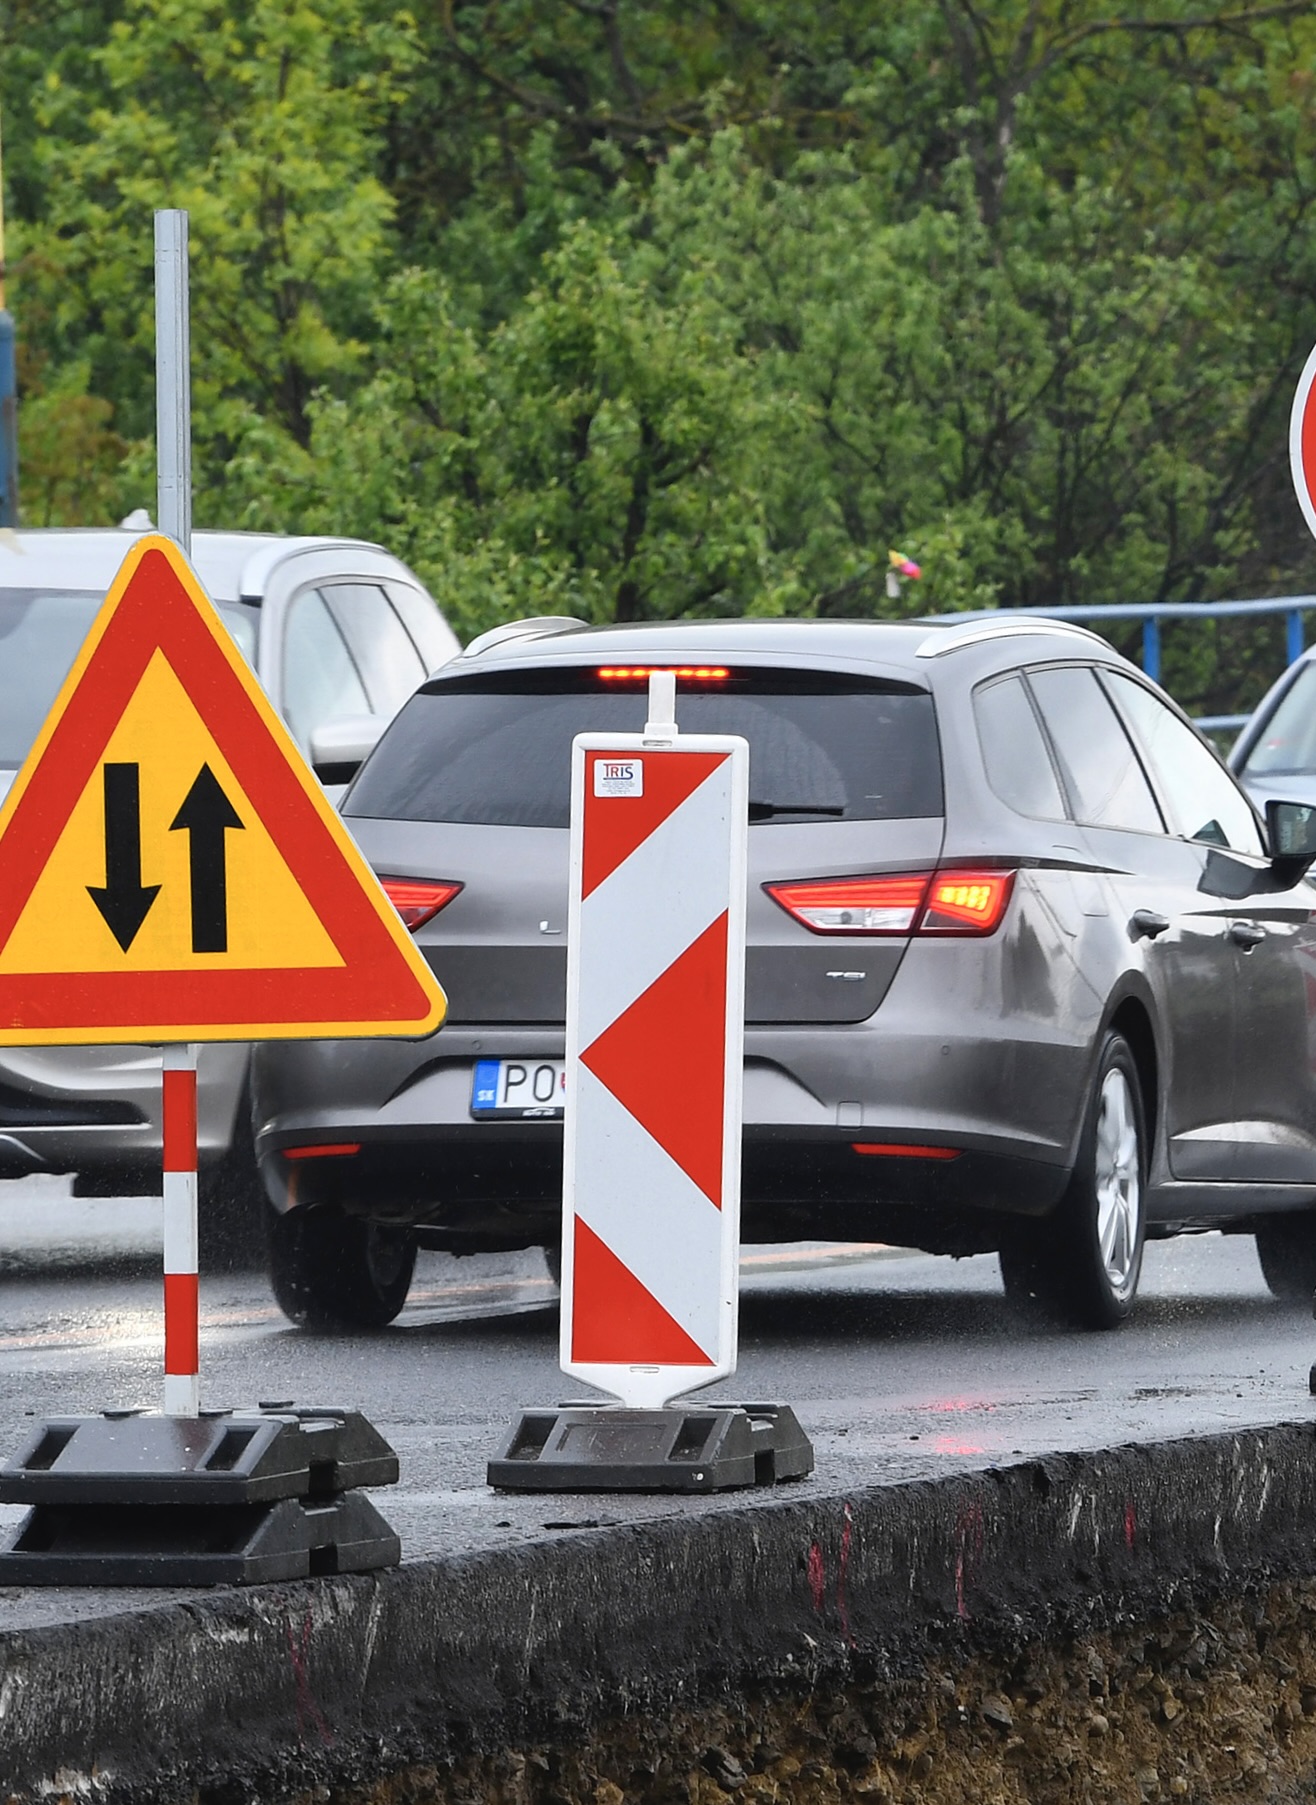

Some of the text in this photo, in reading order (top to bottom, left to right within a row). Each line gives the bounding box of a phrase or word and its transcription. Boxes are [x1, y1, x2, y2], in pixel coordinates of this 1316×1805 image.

[603, 763, 634, 781] TRIS
[477, 1064, 556, 1103] SK PO
